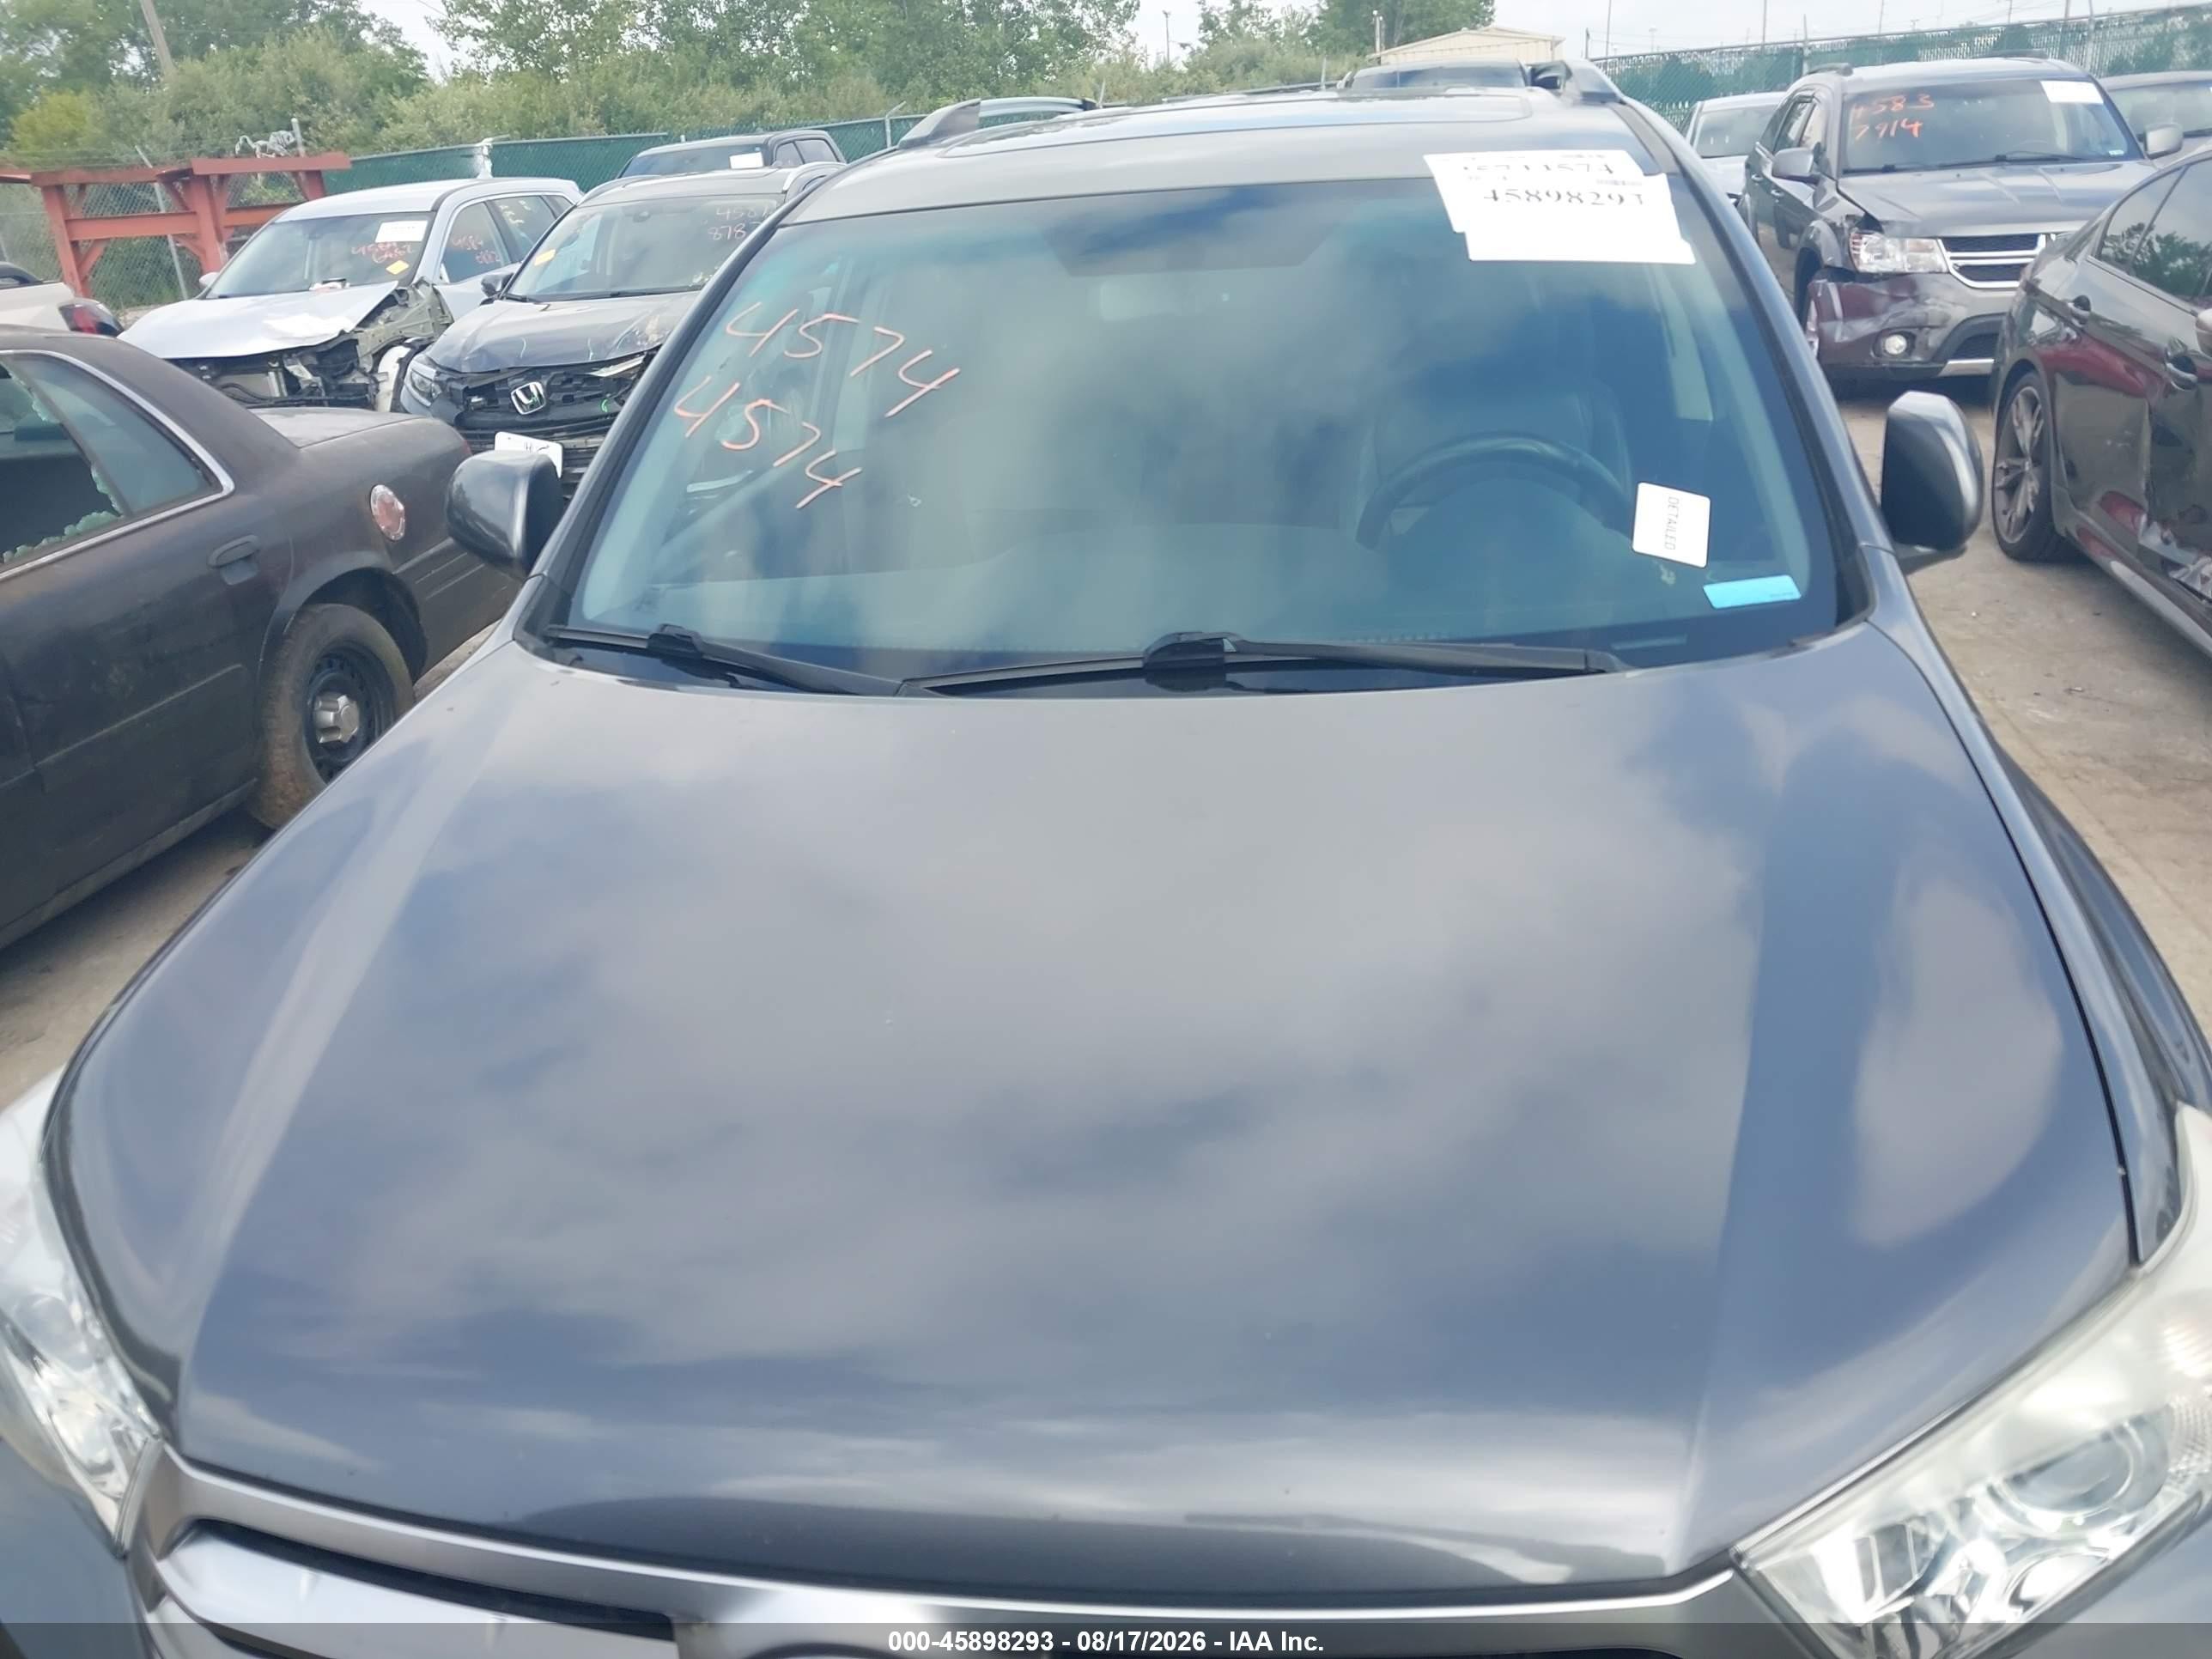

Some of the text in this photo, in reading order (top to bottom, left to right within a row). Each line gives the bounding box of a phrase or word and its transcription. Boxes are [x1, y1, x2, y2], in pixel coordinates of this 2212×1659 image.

[1850, 117, 1924, 141] 7914
[707, 221, 763, 241] 878
[726, 301, 961, 418] 4574
[673, 375, 862, 509] 4574
[1663, 495, 1680, 550] DETAILED
